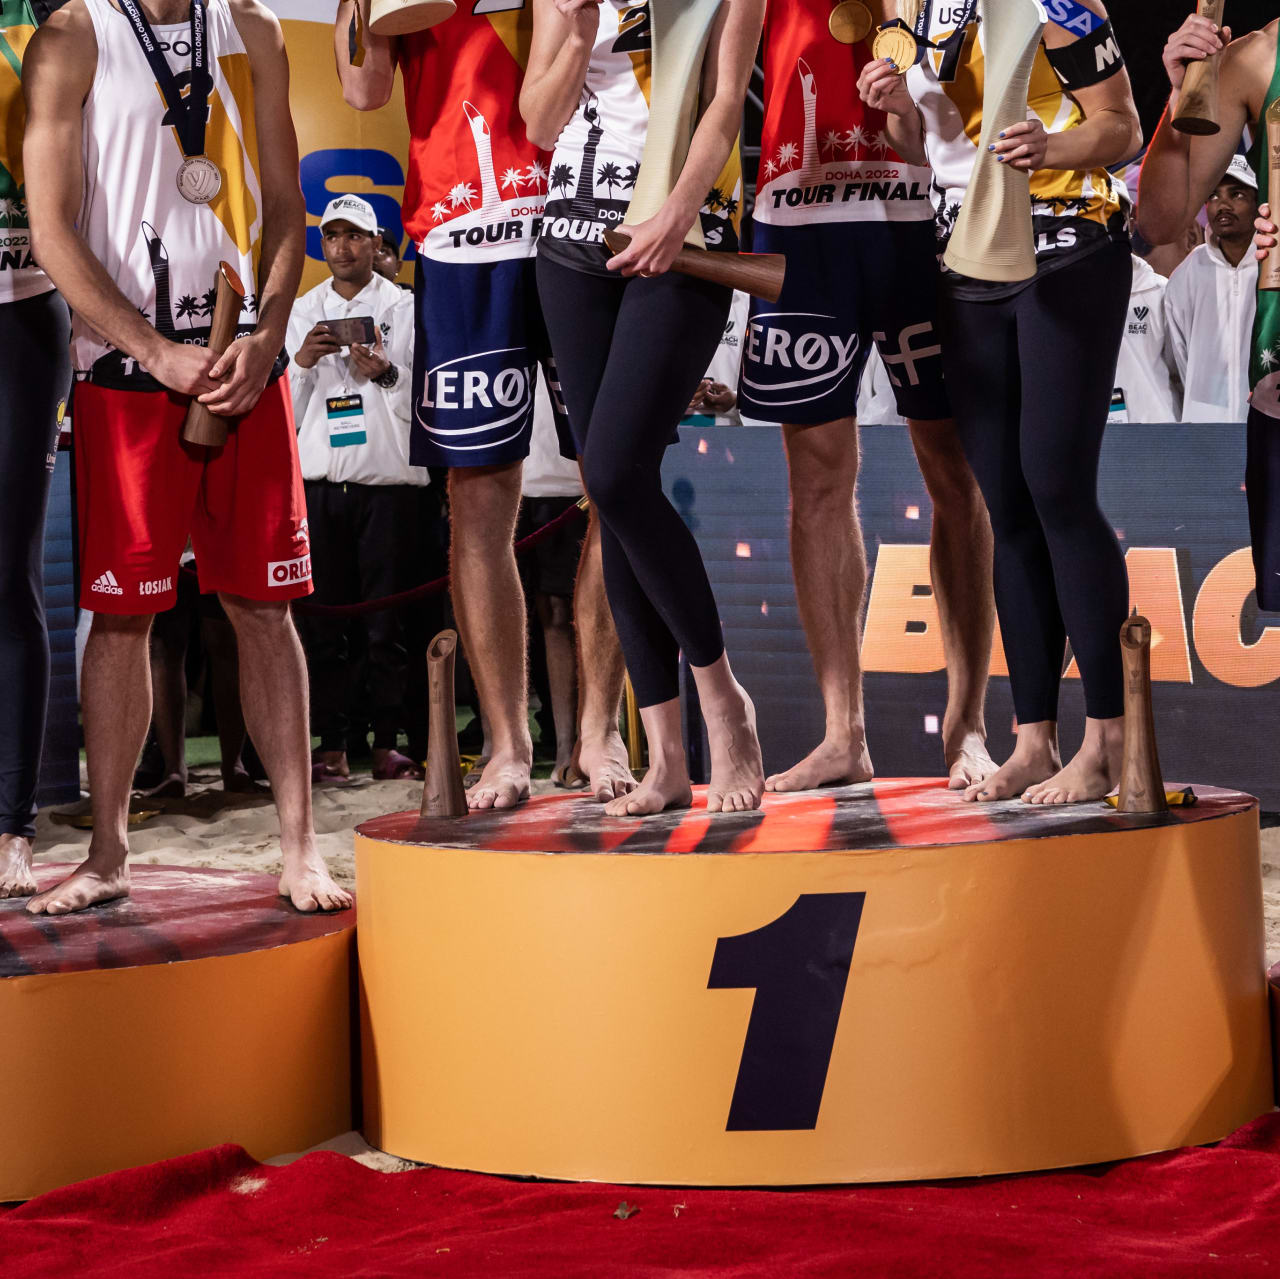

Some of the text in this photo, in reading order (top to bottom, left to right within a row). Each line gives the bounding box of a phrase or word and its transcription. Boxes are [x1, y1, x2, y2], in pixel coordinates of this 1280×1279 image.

[611, 0, 652, 54] 2
[938, 7, 965, 25] US
[958, 9, 971, 29] TOUR
[133, 18, 146, 33] PRO
[142, 31, 155, 53] TOUR
[157, 40, 192, 57] PO
[194, 9, 203, 68] EACH PRO TOUR
[936, 30, 969, 83] 1
[825, 169, 900, 182] DOHA 2022
[771, 184, 837, 209] TOUR
[598, 208, 627, 220] DOH
[448, 219, 524, 248] TOUR
[541, 216, 607, 243] TOUR
[745, 322, 858, 371] ERØY
[271, 560, 312, 583] ORLE
[91, 576, 173, 596] adidas ŁOSIAK
[707, 892, 865, 1131] 1
